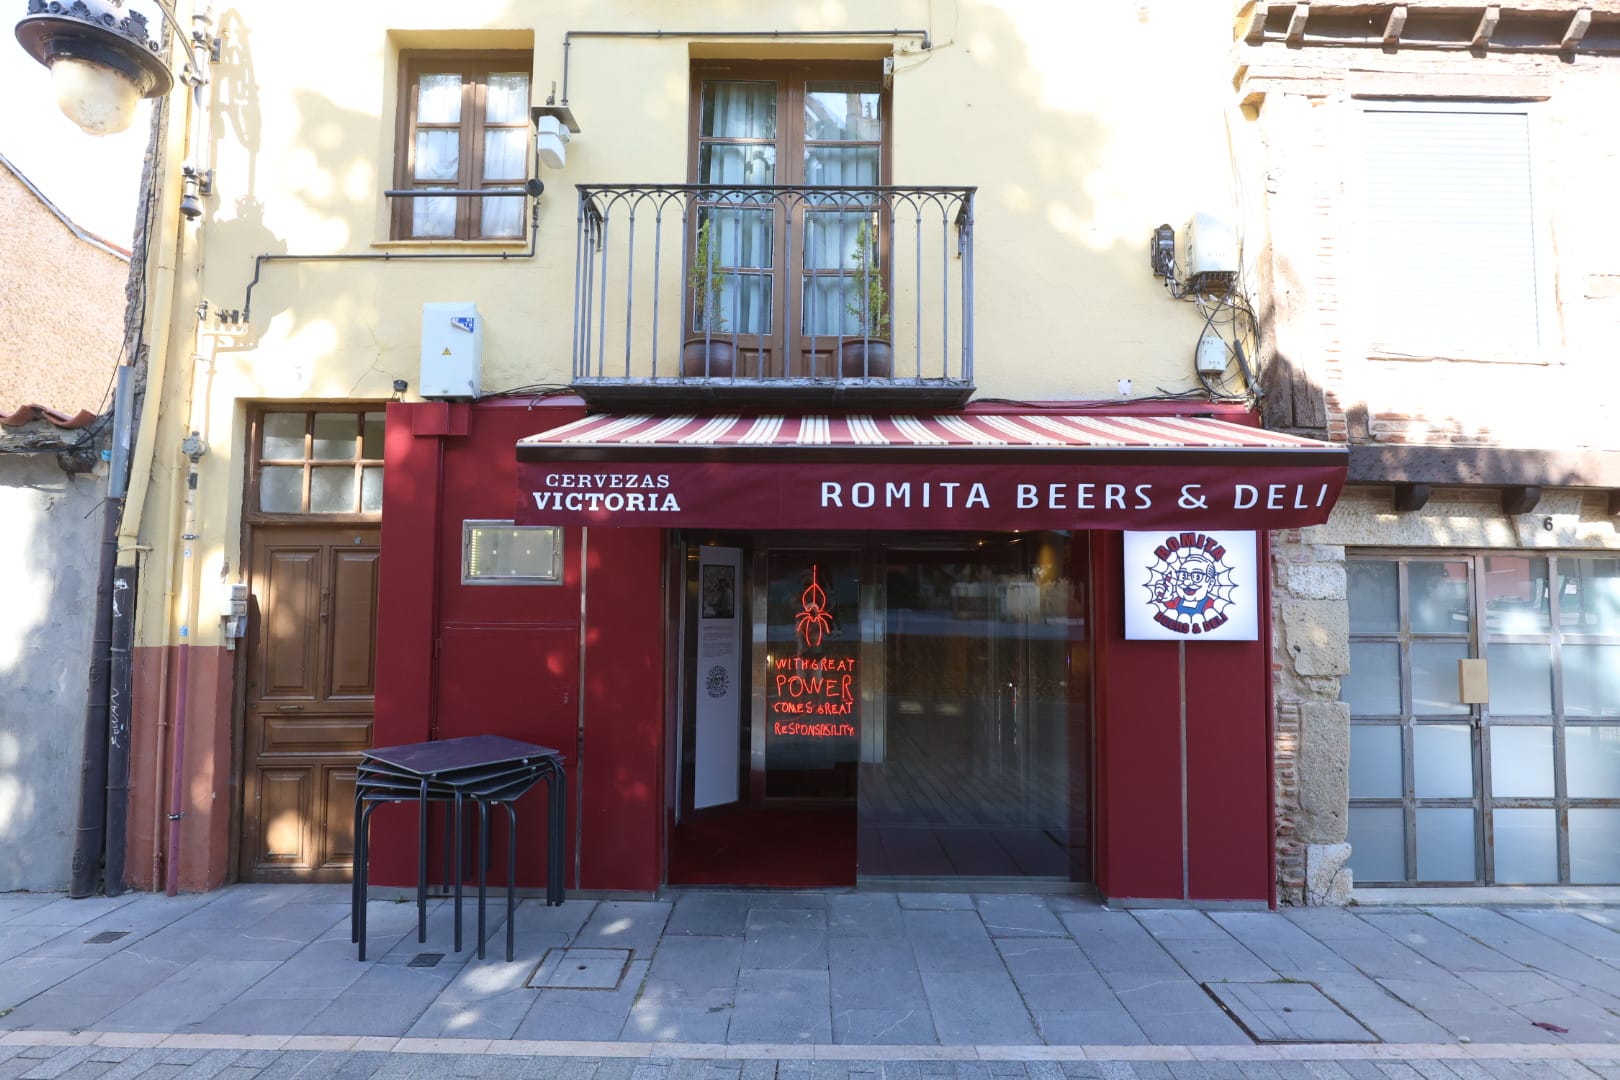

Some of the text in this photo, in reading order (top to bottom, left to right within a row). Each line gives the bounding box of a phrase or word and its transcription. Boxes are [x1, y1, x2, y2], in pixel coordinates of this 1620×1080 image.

[545, 473, 670, 489] CERVEZAS
[532, 491, 681, 512] VICTORIA
[820, 481, 1328, 510] ROMITA BEERS & DELI
[1543, 516, 1554, 531] 6
[1153, 532, 1227, 562] ROMITA
[1153, 611, 1229, 634] BEERS & DELI
[775, 657, 855, 672] WITH GREAT
[776, 674, 855, 702] POWER
[774, 701, 853, 715] COMES GREAT
[774, 722, 855, 737] RESPONSIBILITY
